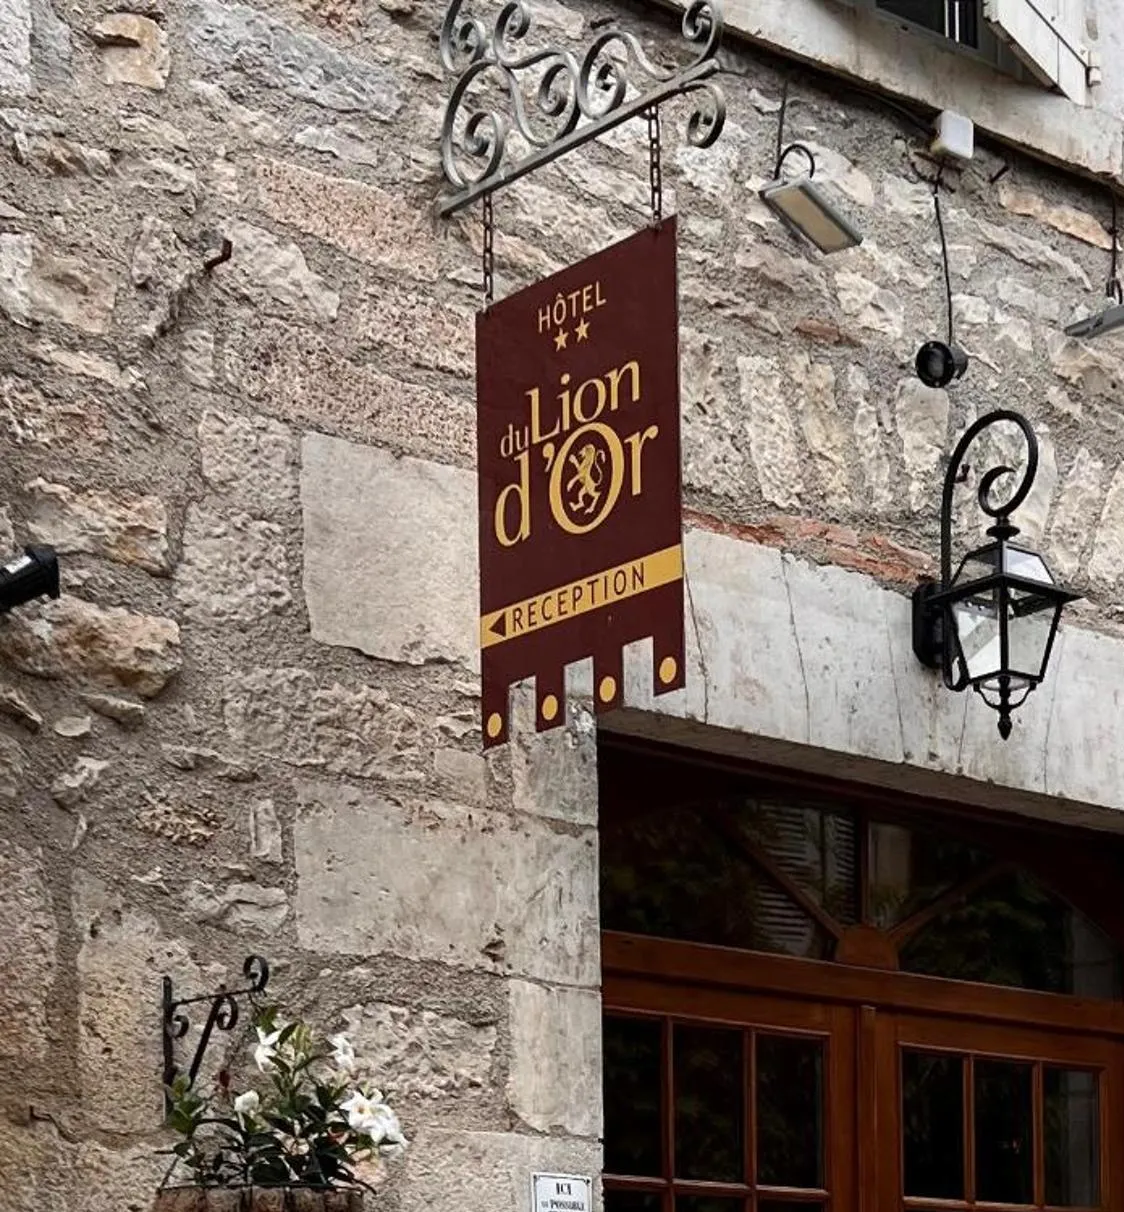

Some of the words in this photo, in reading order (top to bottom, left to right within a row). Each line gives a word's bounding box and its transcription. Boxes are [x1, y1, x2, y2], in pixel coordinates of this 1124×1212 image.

[537, 280, 607, 334] HÔTEL
[499, 422, 530, 459] du
[525, 358, 641, 446] Lion
[494, 421, 660, 548] d'Or
[511, 560, 647, 633] RECEPTION
